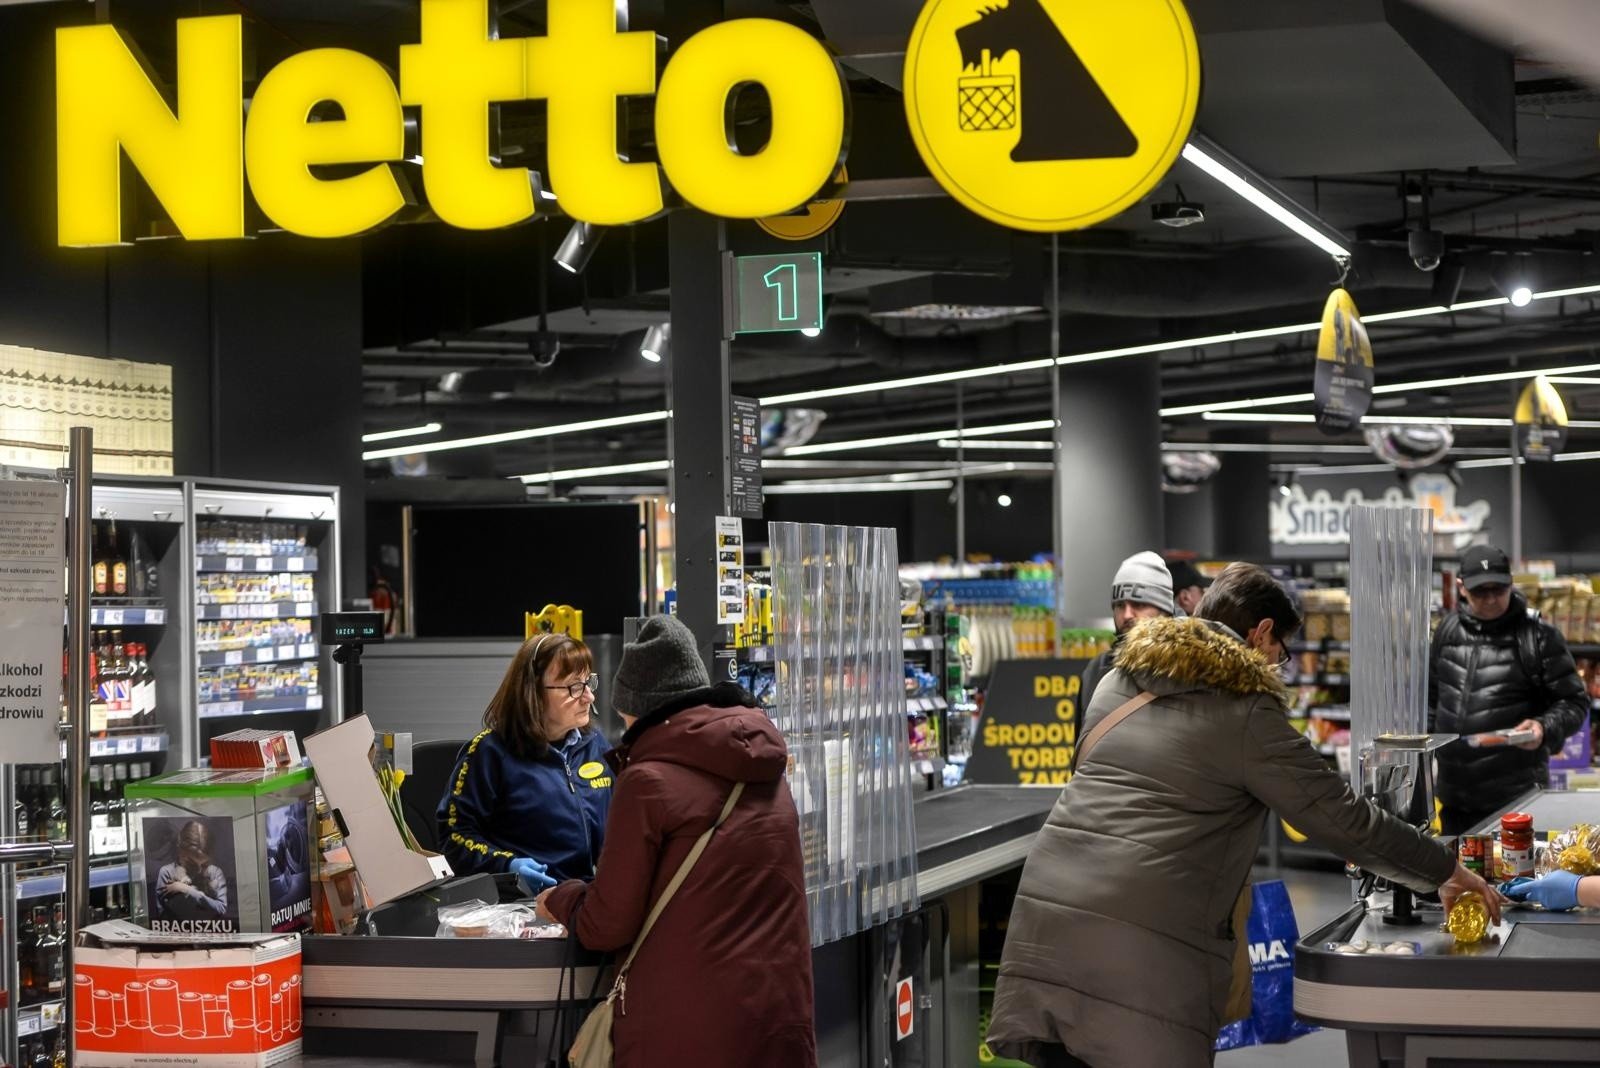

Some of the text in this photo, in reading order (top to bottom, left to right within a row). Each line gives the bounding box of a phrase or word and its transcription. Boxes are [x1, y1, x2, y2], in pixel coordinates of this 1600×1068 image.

[56, 0, 843, 246] Netto
[763, 263, 797, 320] 1
[1112, 583, 1145, 599] UFC
[0, 663, 43, 676] lkohol
[1056, 699, 1075, 720] O
[1008, 747, 1075, 769] TORB
[271, 909, 293, 926] RATUJ
[294, 898, 312, 917] MNIE
[151, 919, 237, 934] BRACISZKU,
